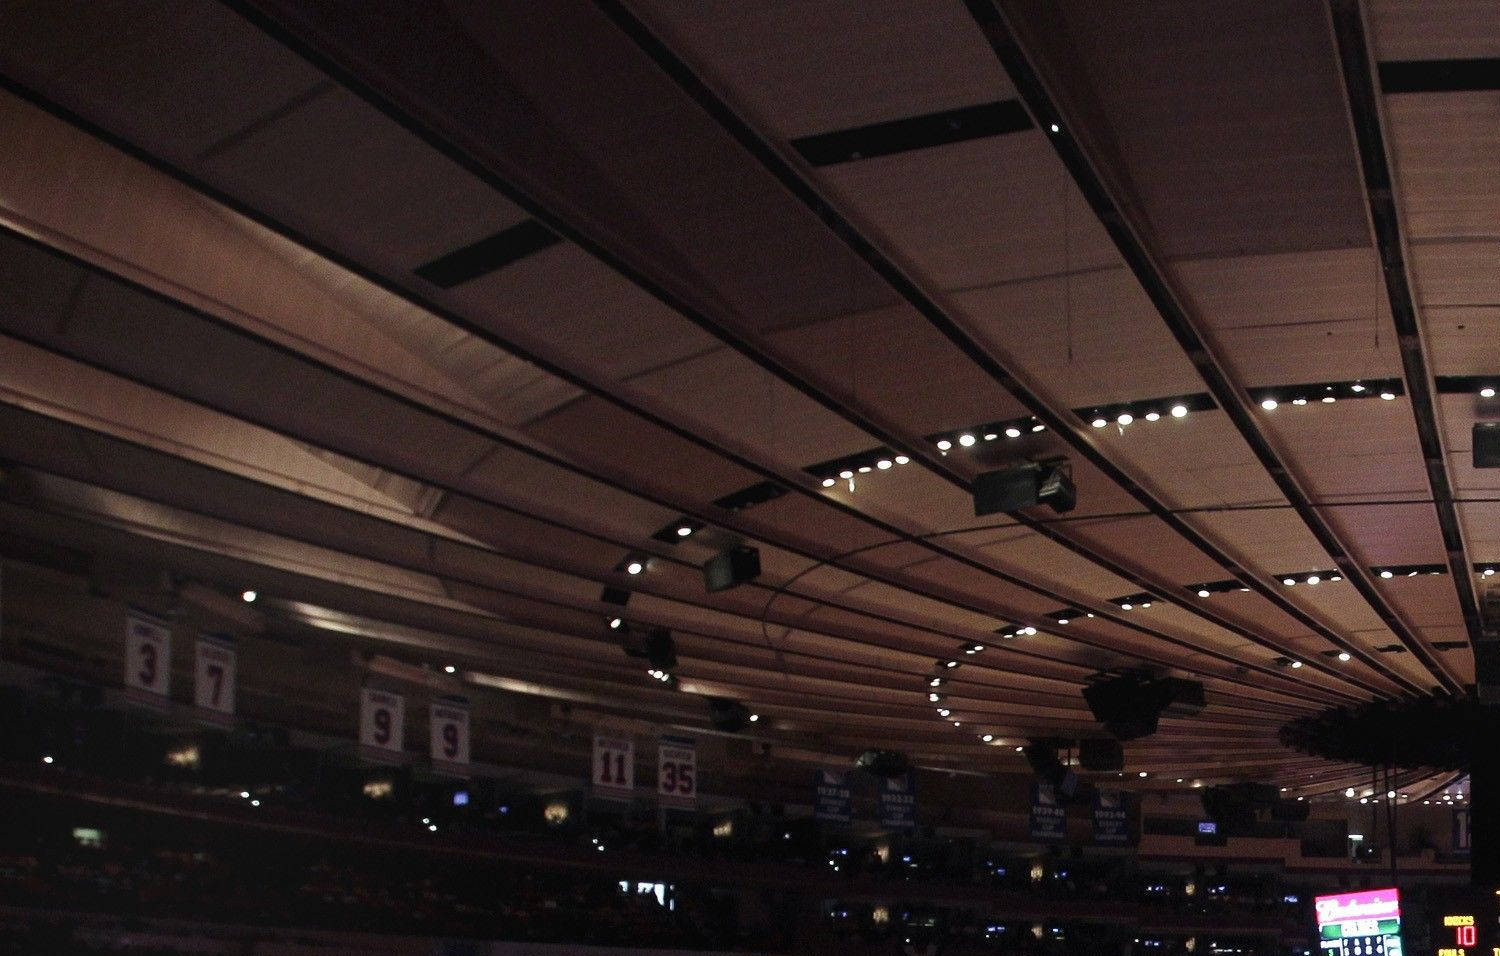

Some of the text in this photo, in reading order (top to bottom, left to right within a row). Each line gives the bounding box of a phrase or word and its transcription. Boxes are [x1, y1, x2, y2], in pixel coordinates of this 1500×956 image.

[140, 643, 155, 684] 3
[208, 664, 223, 706] 7
[375, 709, 390, 744] 9
[442, 724, 458, 760] 9
[601, 752, 627, 784] 11
[663, 761, 693, 793] 35
[1457, 925, 1477, 947] 10
